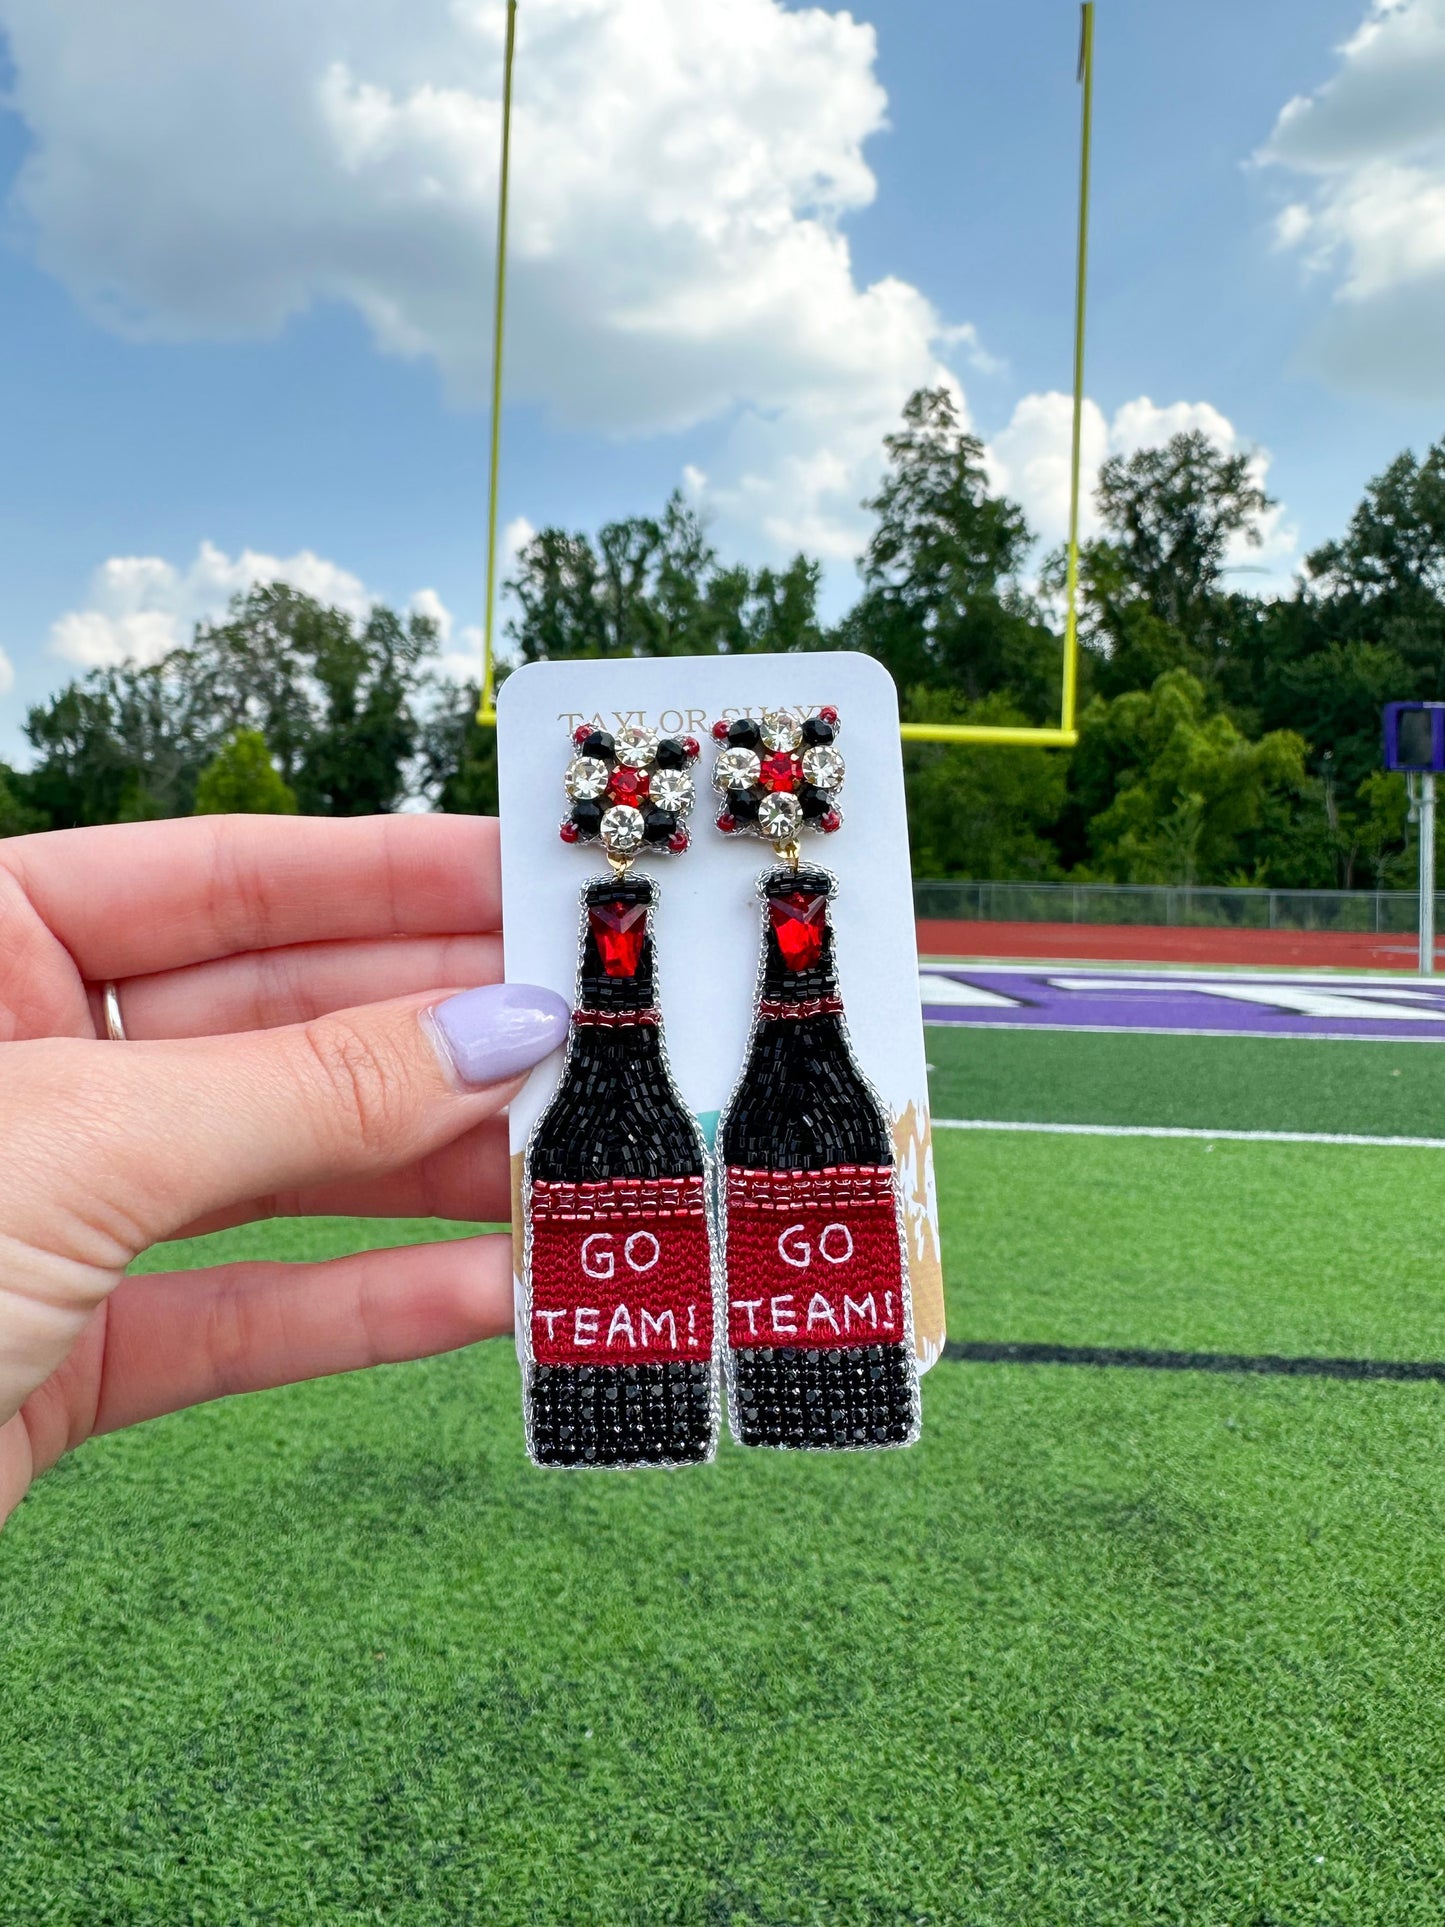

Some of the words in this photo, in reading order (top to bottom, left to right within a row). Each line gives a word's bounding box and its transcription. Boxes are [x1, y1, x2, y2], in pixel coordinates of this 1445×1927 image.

[557, 709, 709, 737] TAYLOR
[721, 705, 838, 728] SHY
[581, 1230, 660, 1279] GO
[778, 1222, 854, 1268] GO
[535, 1303, 699, 1350] TEAM!
[731, 1290, 896, 1336] TEAM!
